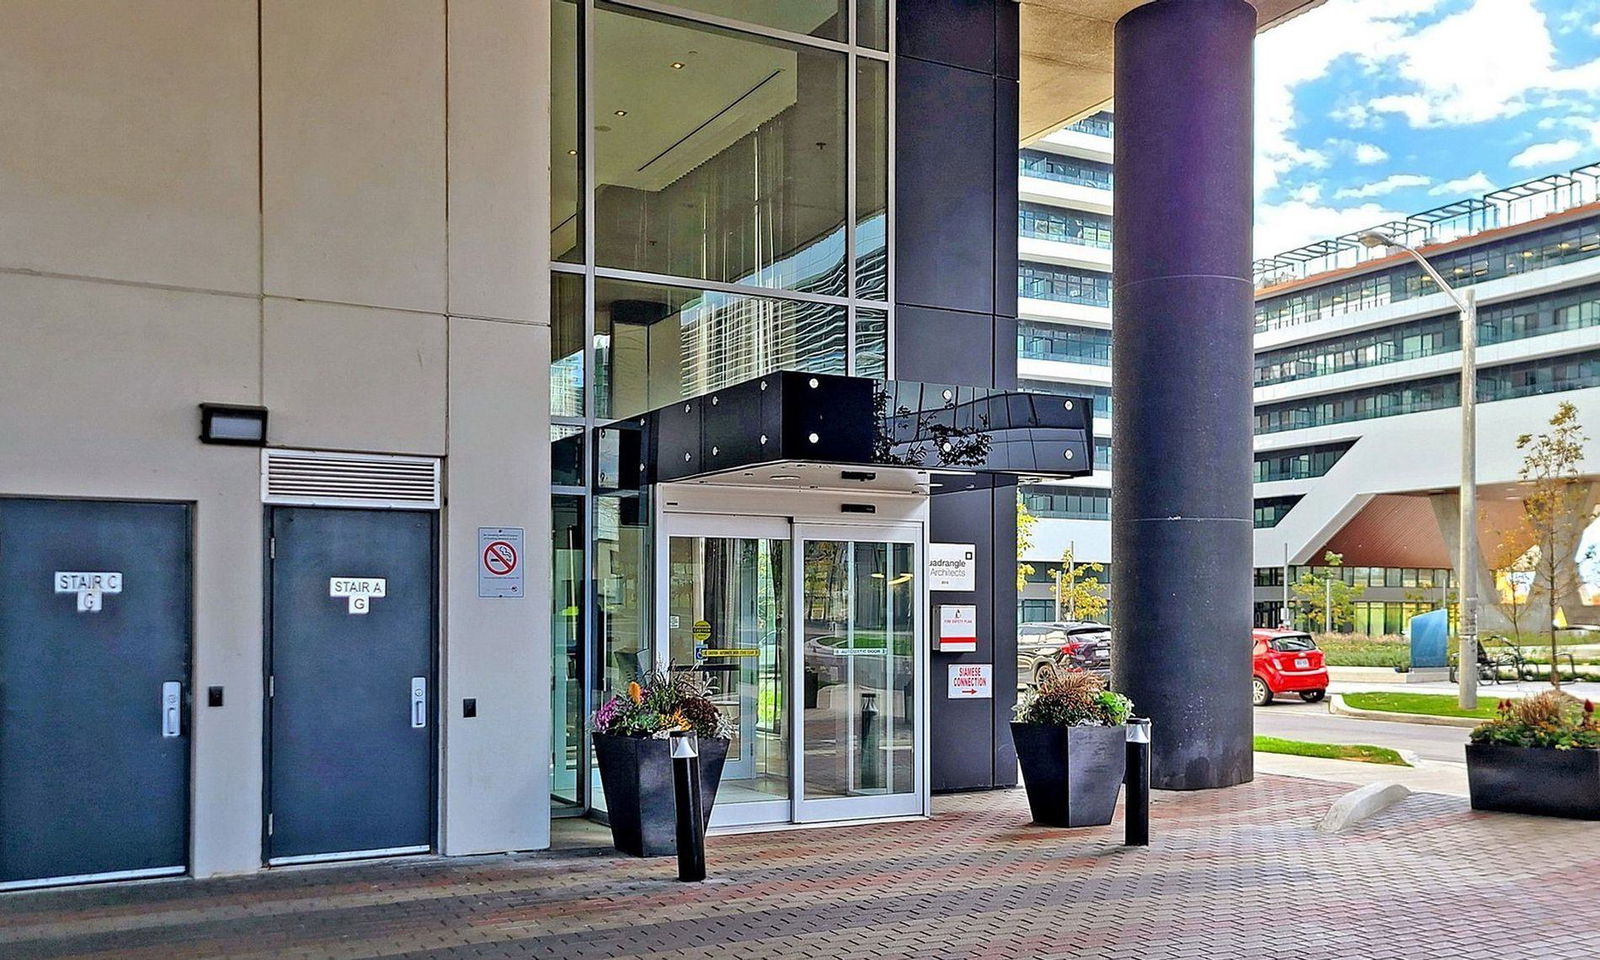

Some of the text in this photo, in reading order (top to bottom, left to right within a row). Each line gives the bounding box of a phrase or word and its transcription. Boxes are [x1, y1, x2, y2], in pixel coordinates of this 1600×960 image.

[930, 568, 966, 577] Architects
[60, 575, 116, 589] STAIR C
[335, 581, 382, 592] STAIR A
[83, 593, 94, 609] G
[354, 598, 365, 609] G
[959, 667, 981, 677] SIAMESE
[953, 677, 987, 687] CONNECTION
